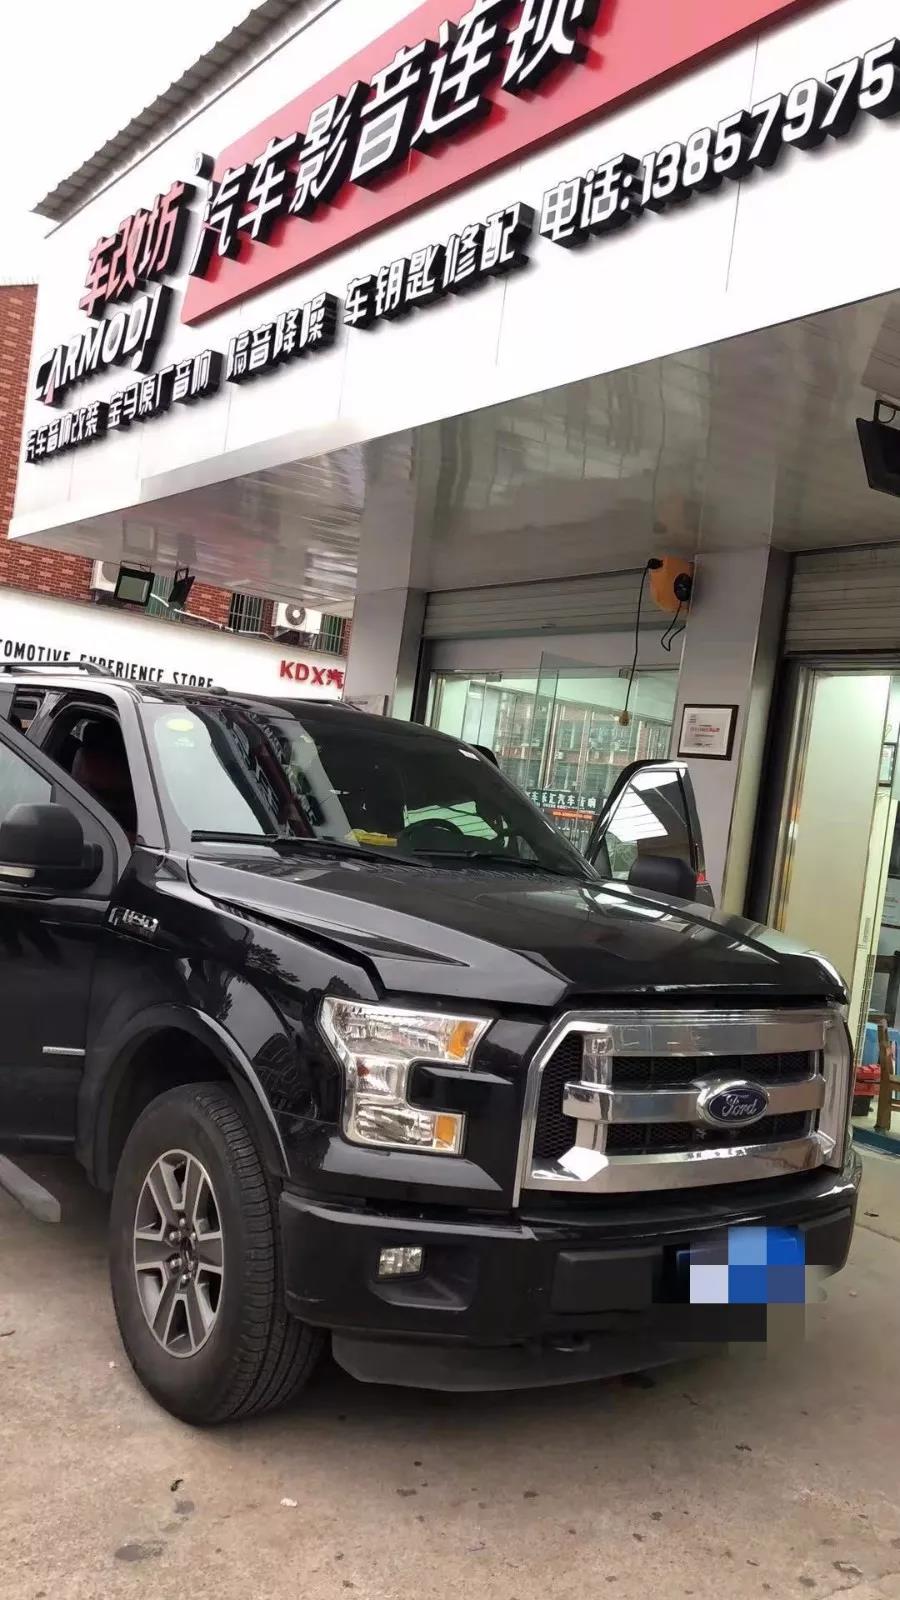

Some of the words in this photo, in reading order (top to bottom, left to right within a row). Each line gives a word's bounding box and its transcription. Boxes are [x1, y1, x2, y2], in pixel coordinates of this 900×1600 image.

[79, 181, 184, 317] 车改坊
[25, 401, 101, 463] 汽车音响改装
[107, 350, 212, 429] 宝马原厂音响
[344, 203, 521, 327] 车钥匙修配
[0, 638, 71, 662] OMOTIVE
[721, 1094, 758, 1117] Ford
